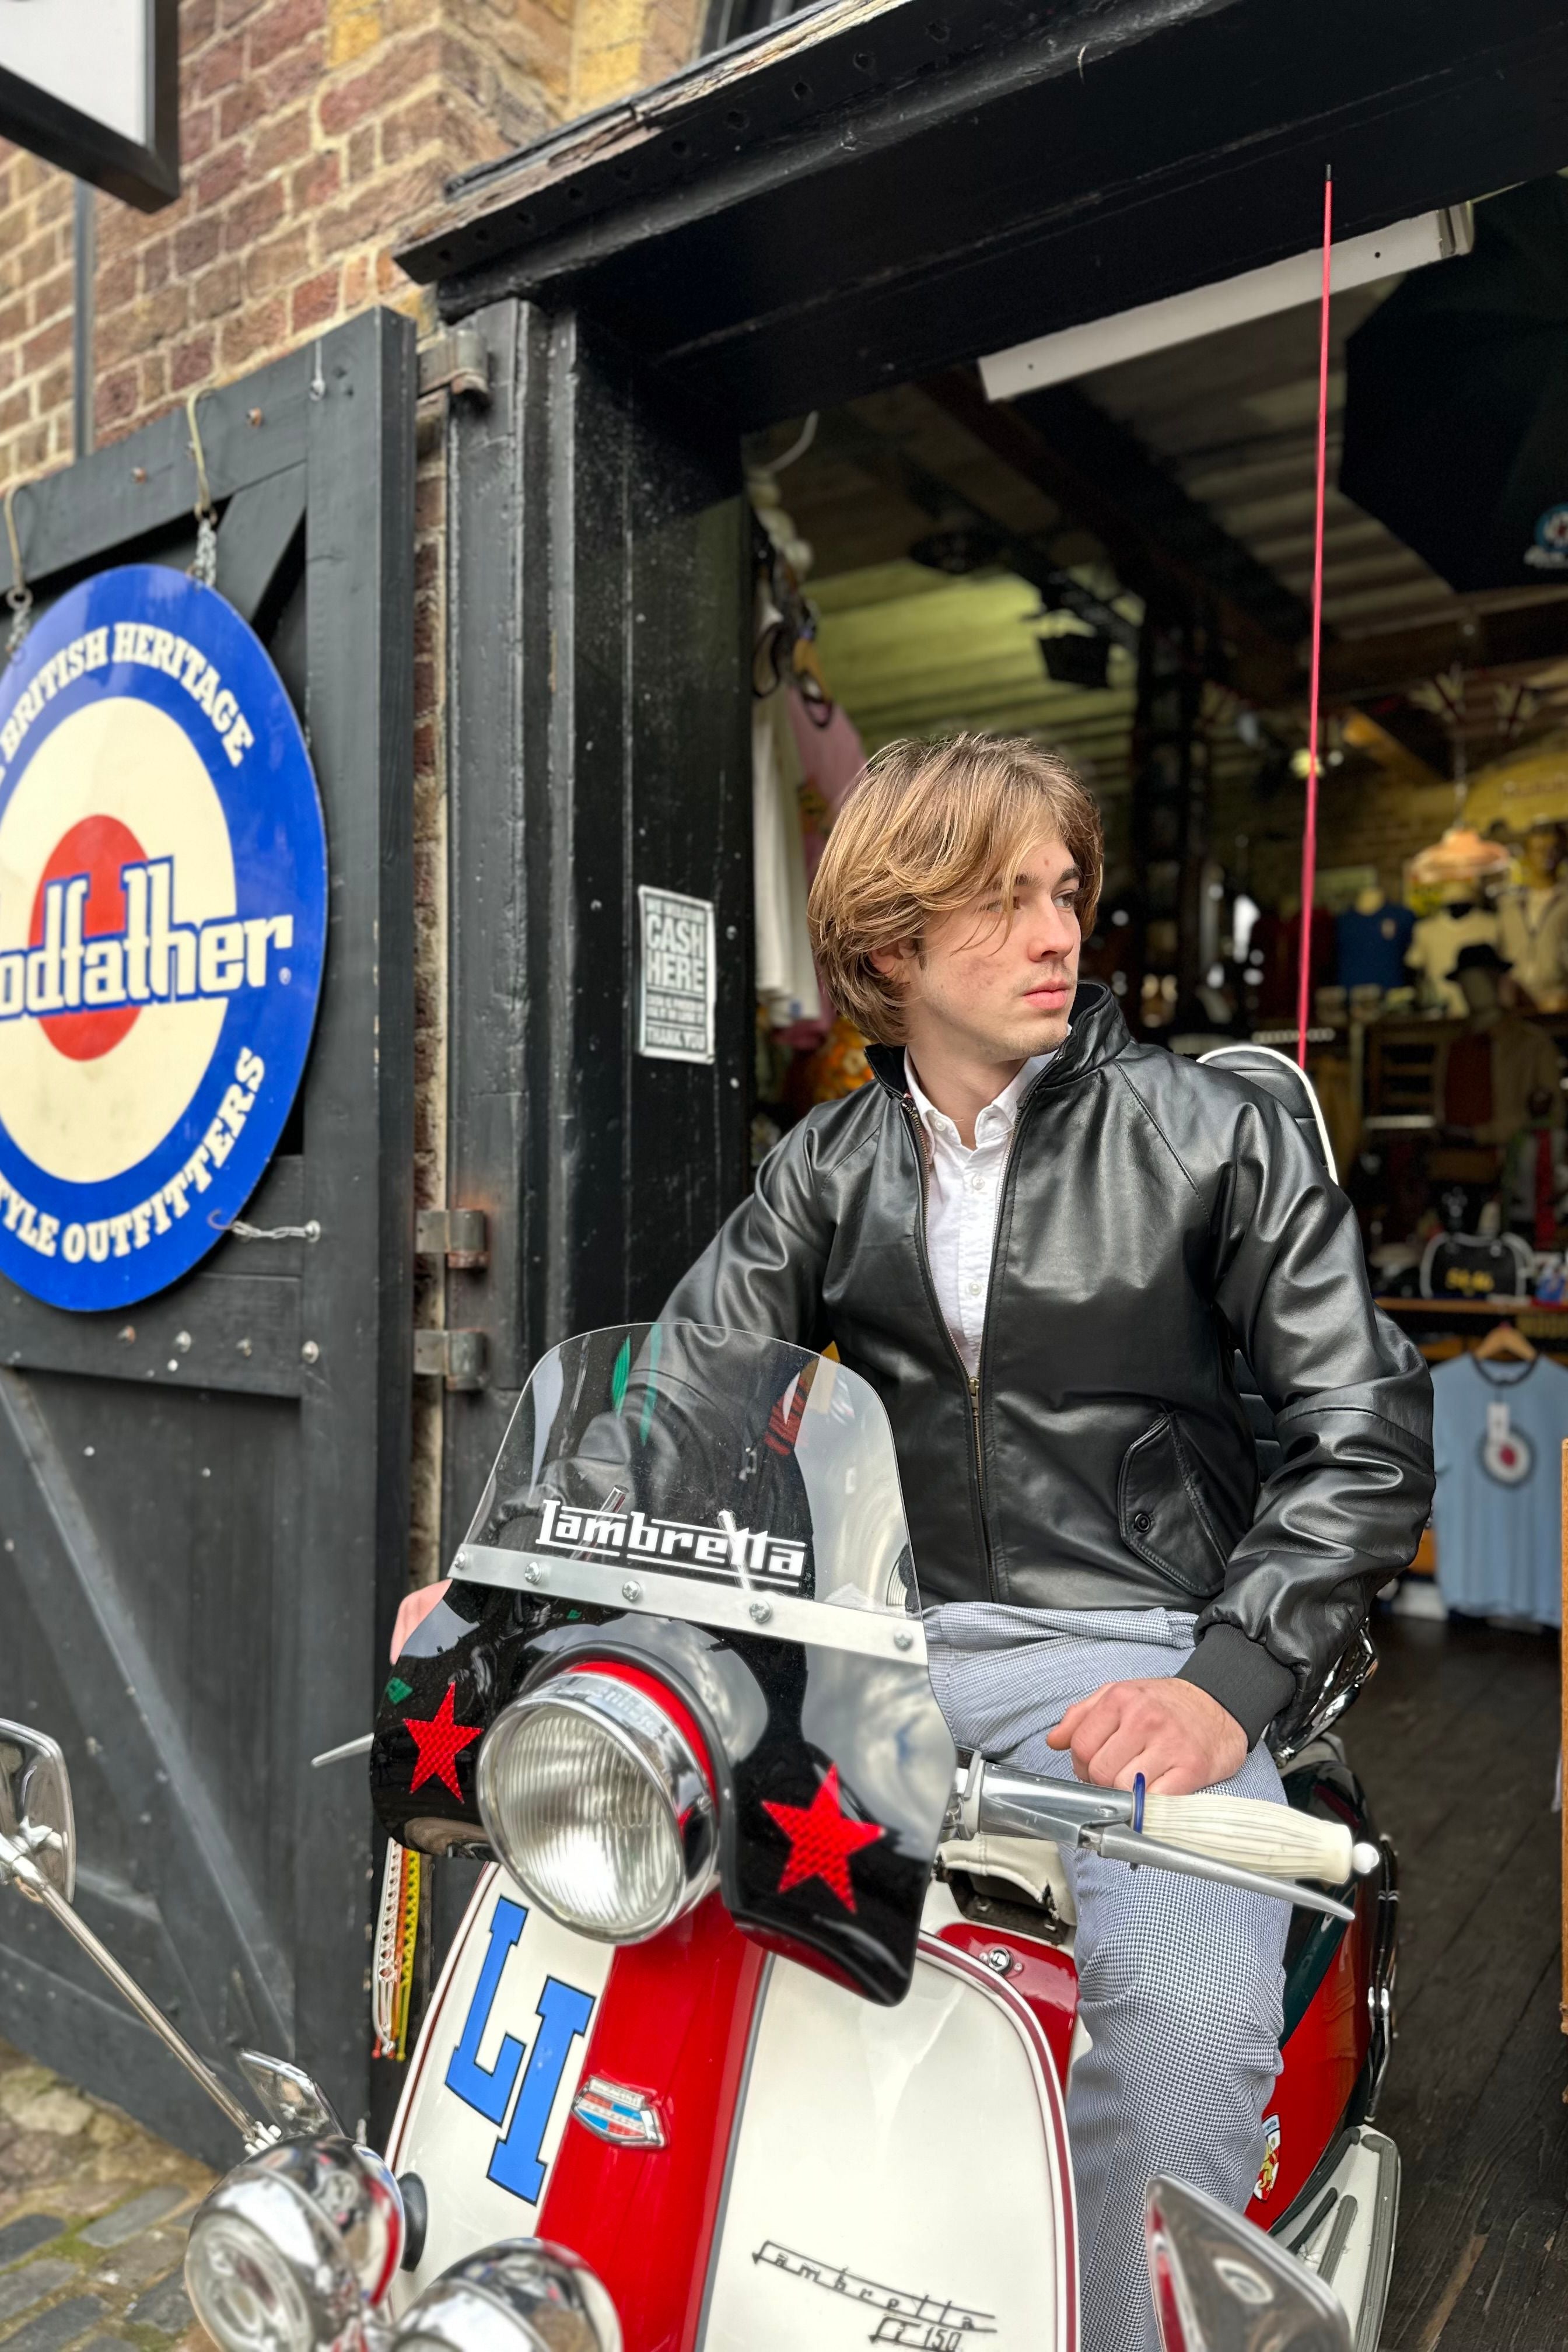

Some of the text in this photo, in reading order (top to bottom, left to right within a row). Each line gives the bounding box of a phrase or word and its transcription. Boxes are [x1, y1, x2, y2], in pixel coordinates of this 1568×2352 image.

[0, 622, 254, 767] BRITISH HERITAGE
[646, 913, 705, 958] CASH
[646, 949, 705, 992] HERE
[62, 1047, 265, 1264] OUTFITTERS
[536, 1499, 806, 1586] Lambretta
[751, 2239, 998, 2333] Lambretta
